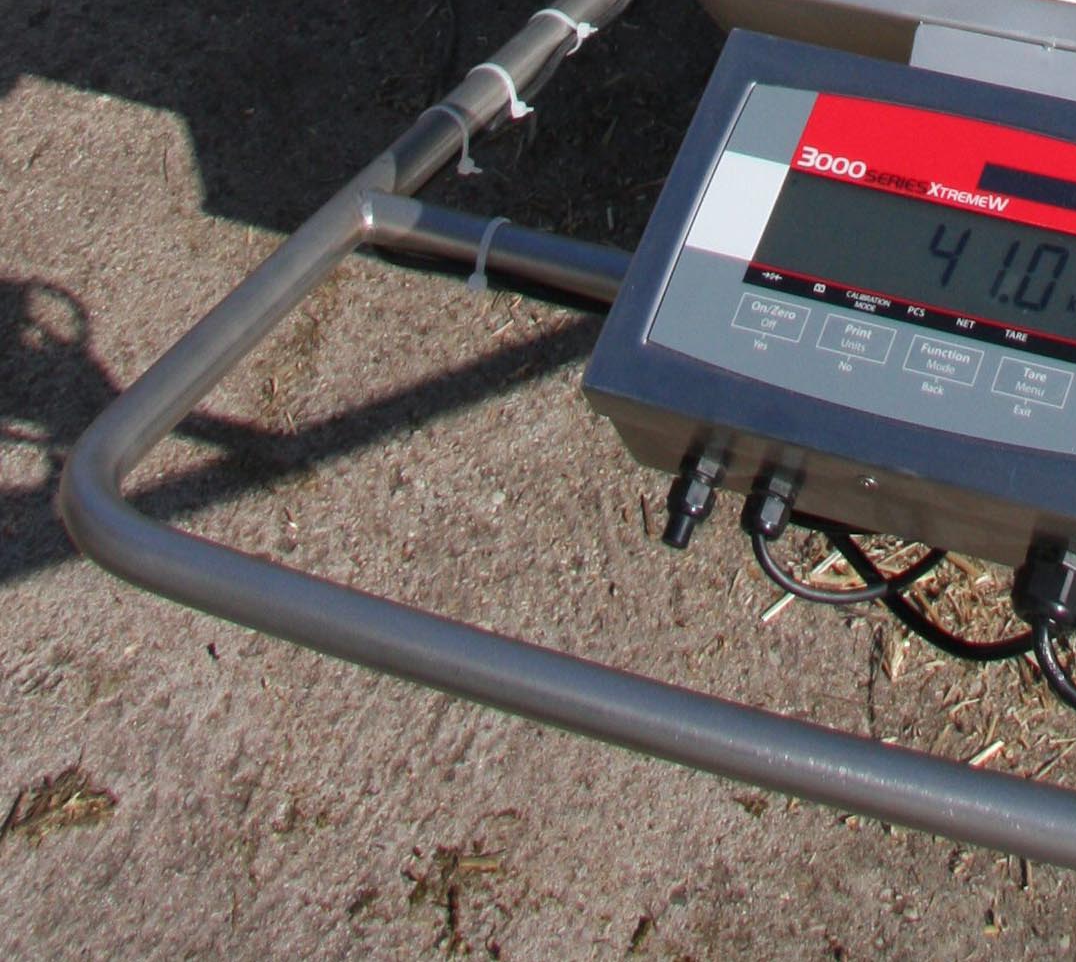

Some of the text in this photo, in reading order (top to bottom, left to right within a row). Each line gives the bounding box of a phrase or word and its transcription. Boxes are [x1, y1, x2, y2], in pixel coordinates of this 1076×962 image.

[797, 145, 1009, 212] 3000 SERIES XTREMEW
[930, 224, 1069, 311] 41.0
[846, 291, 892, 308] CALIBRATION
[751, 301, 797, 320] On/Zero
[854, 302, 876, 313] MODE
[907, 305, 925, 318] PCS
[761, 318, 777, 331] Off
[956, 318, 976, 329] NET
[844, 324, 873, 340] Print
[1005, 329, 1028, 342] TARE
[754, 340, 768, 351] Yes
[841, 339, 866, 353] Units
[920, 342, 970, 363] Function
[838, 361, 852, 372] No
[926, 359, 955, 375] Mode
[1023, 367, 1047, 383] Tare
[921, 382, 944, 396] Back
[1016, 381, 1045, 397] Menu
[1013, 405, 1032, 418] Exit
